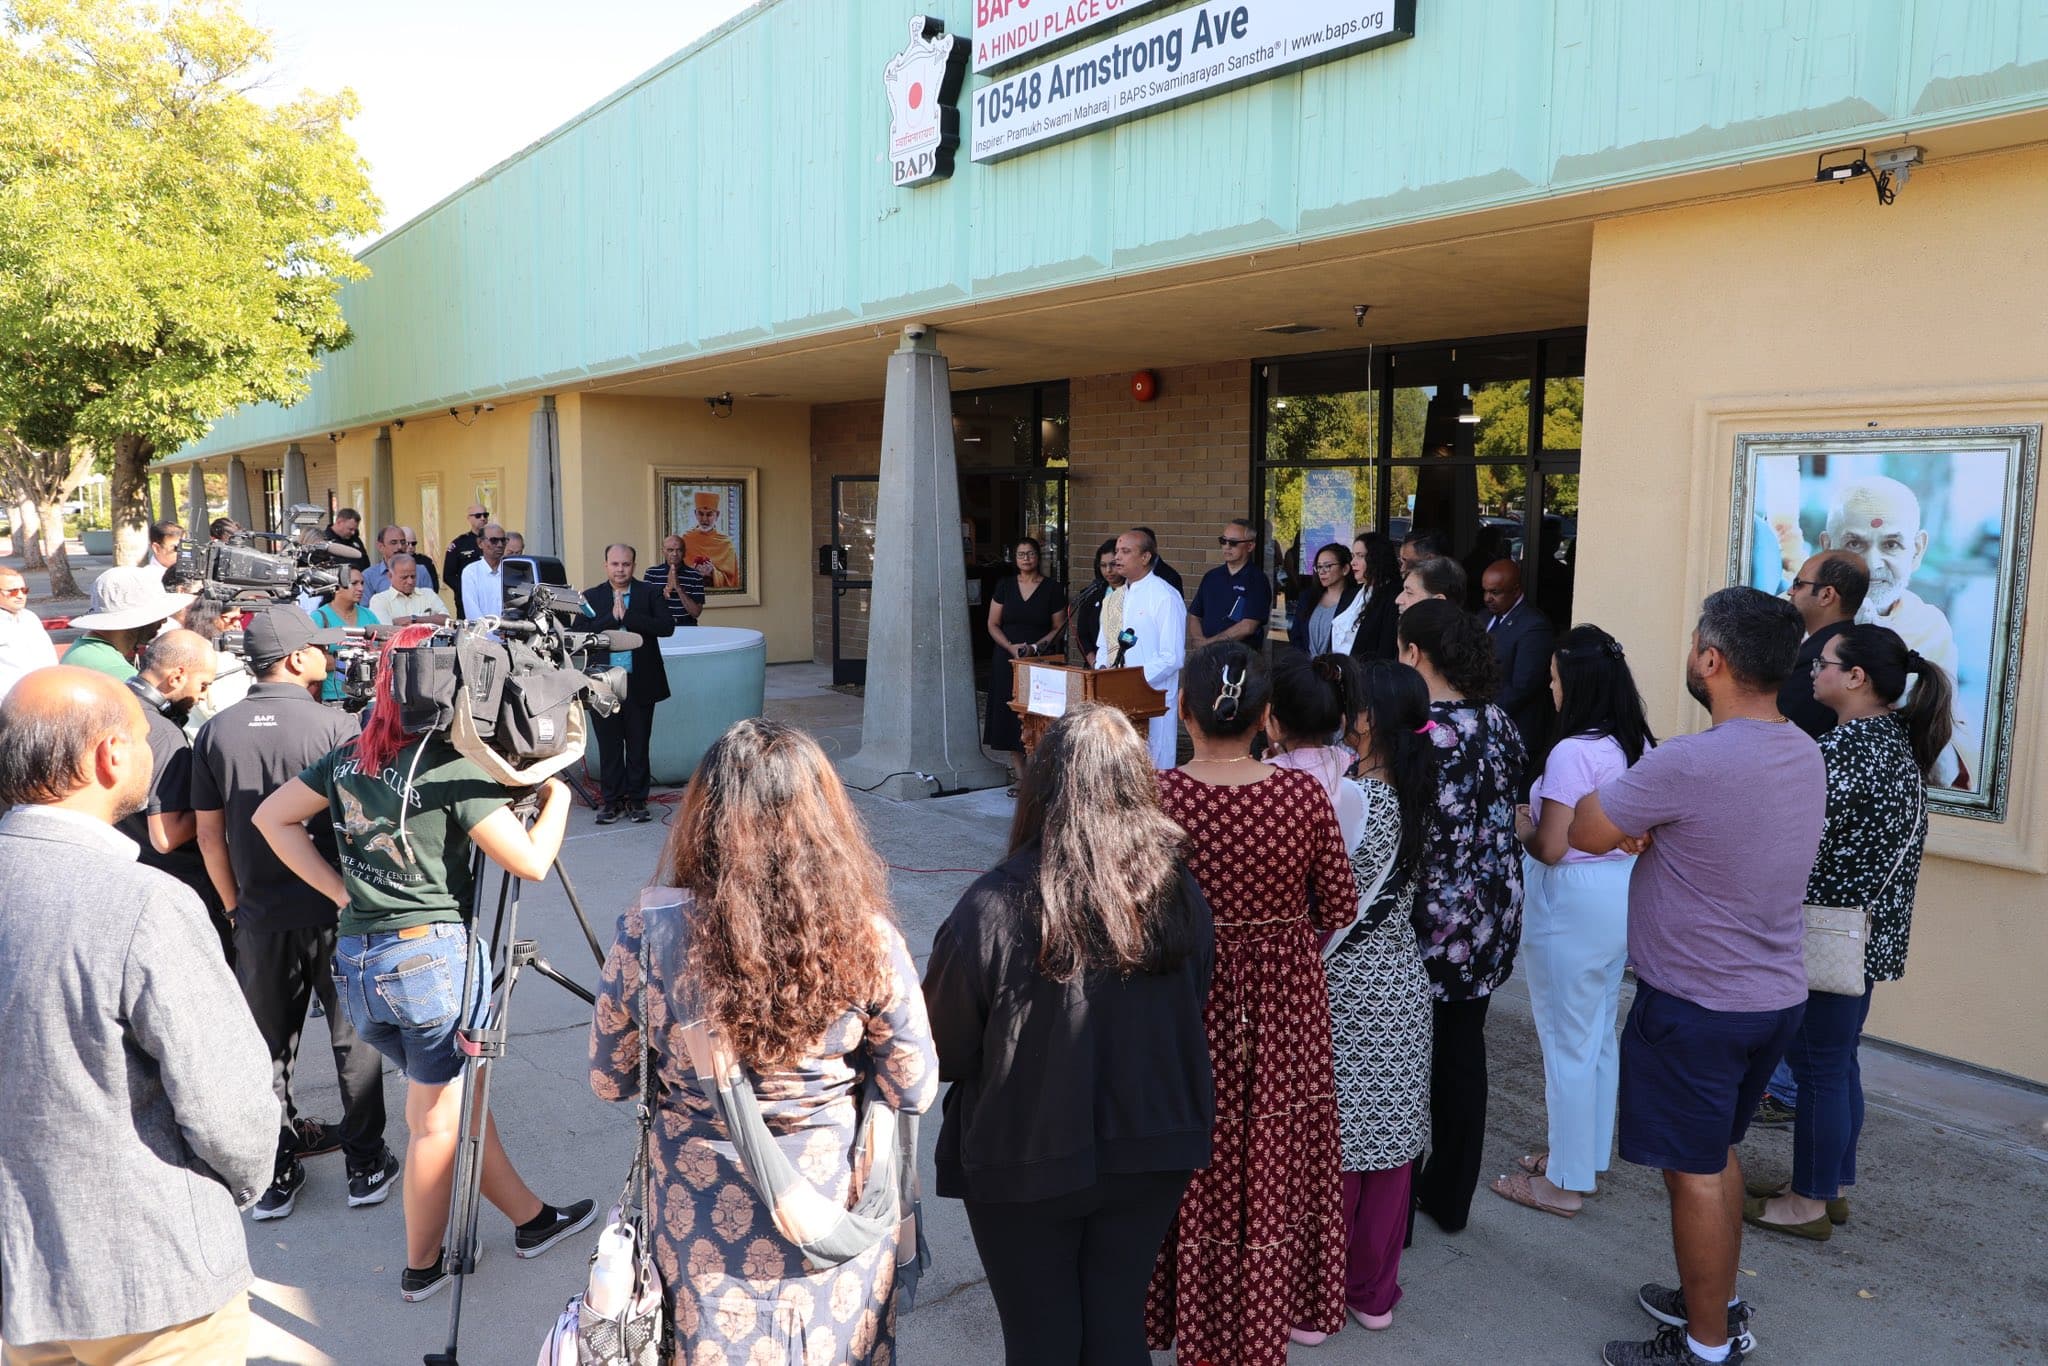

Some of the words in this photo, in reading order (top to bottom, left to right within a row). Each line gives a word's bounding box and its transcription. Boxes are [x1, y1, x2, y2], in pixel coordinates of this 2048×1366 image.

[978, 0, 1030, 28] BAP
[978, 43, 988, 64] A
[991, 19, 1038, 58] HINDU
[1044, 0, 1100, 38] PLACE
[975, 134, 1005, 153] Inspirer:
[1007, 121, 1042, 143] Pramukh
[1044, 111, 1072, 130] Swami
[1074, 98, 1110, 121] Maharaj
[1120, 85, 1147, 106] BAPS
[1149, 62, 1225, 97] Swaminarayan
[1291, 11, 1384, 51] www.baps.org
[977, 72, 1042, 127] 10548
[1048, 28, 1183, 103] Armstrong
[1190, 6, 1249, 54] Ave
[895, 150, 934, 181] BAPS
[383, 767, 422, 808] CLUB
